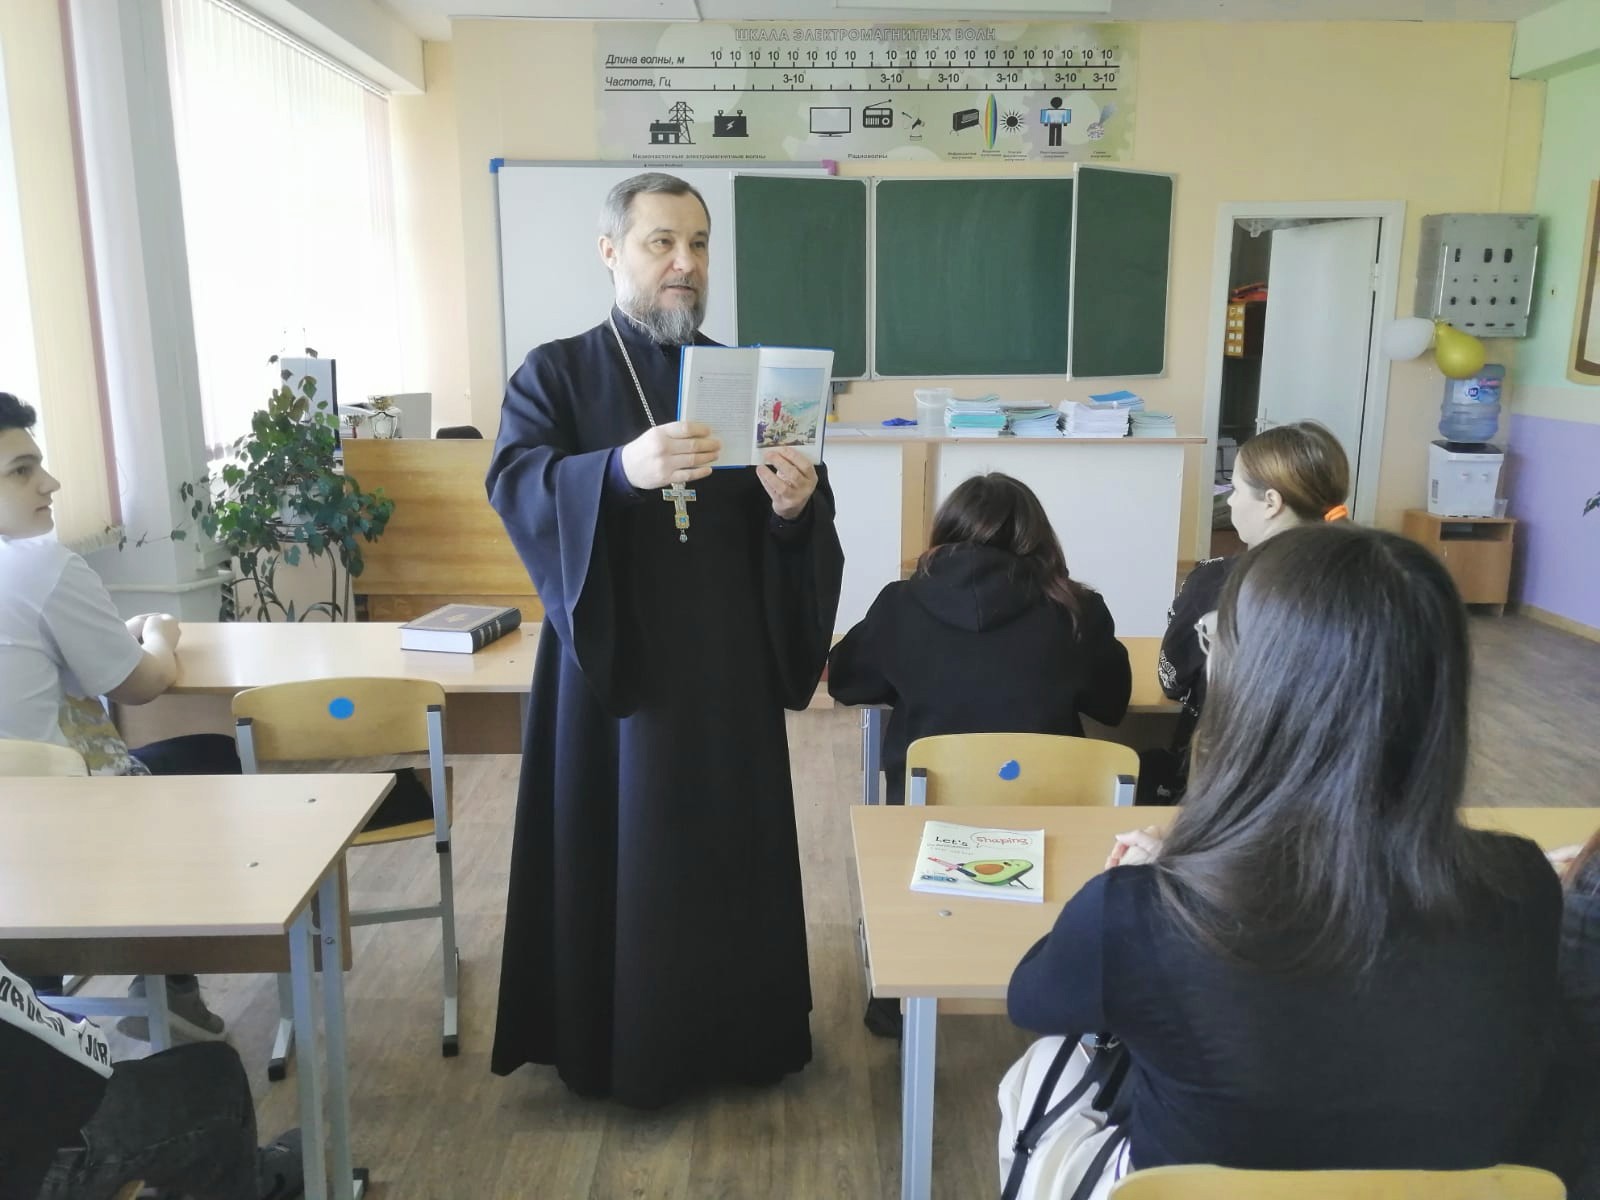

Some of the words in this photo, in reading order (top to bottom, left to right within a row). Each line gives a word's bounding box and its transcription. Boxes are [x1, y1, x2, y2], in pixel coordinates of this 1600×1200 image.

[735, 28, 790, 41] ШКАЛА
[793, 28, 951, 41] ЭЛЕКТРОМАГНИТНЫХ
[955, 28, 996, 41] ВОЛН
[605, 54, 638, 65] Длина
[640, 56, 674, 65] волны,
[676, 56, 685, 64] м
[605, 76, 656, 88] Частота,
[659, 76, 671, 88] Гц
[935, 835, 969, 847] Let's
[85, 1034, 112, 1067] JOR
